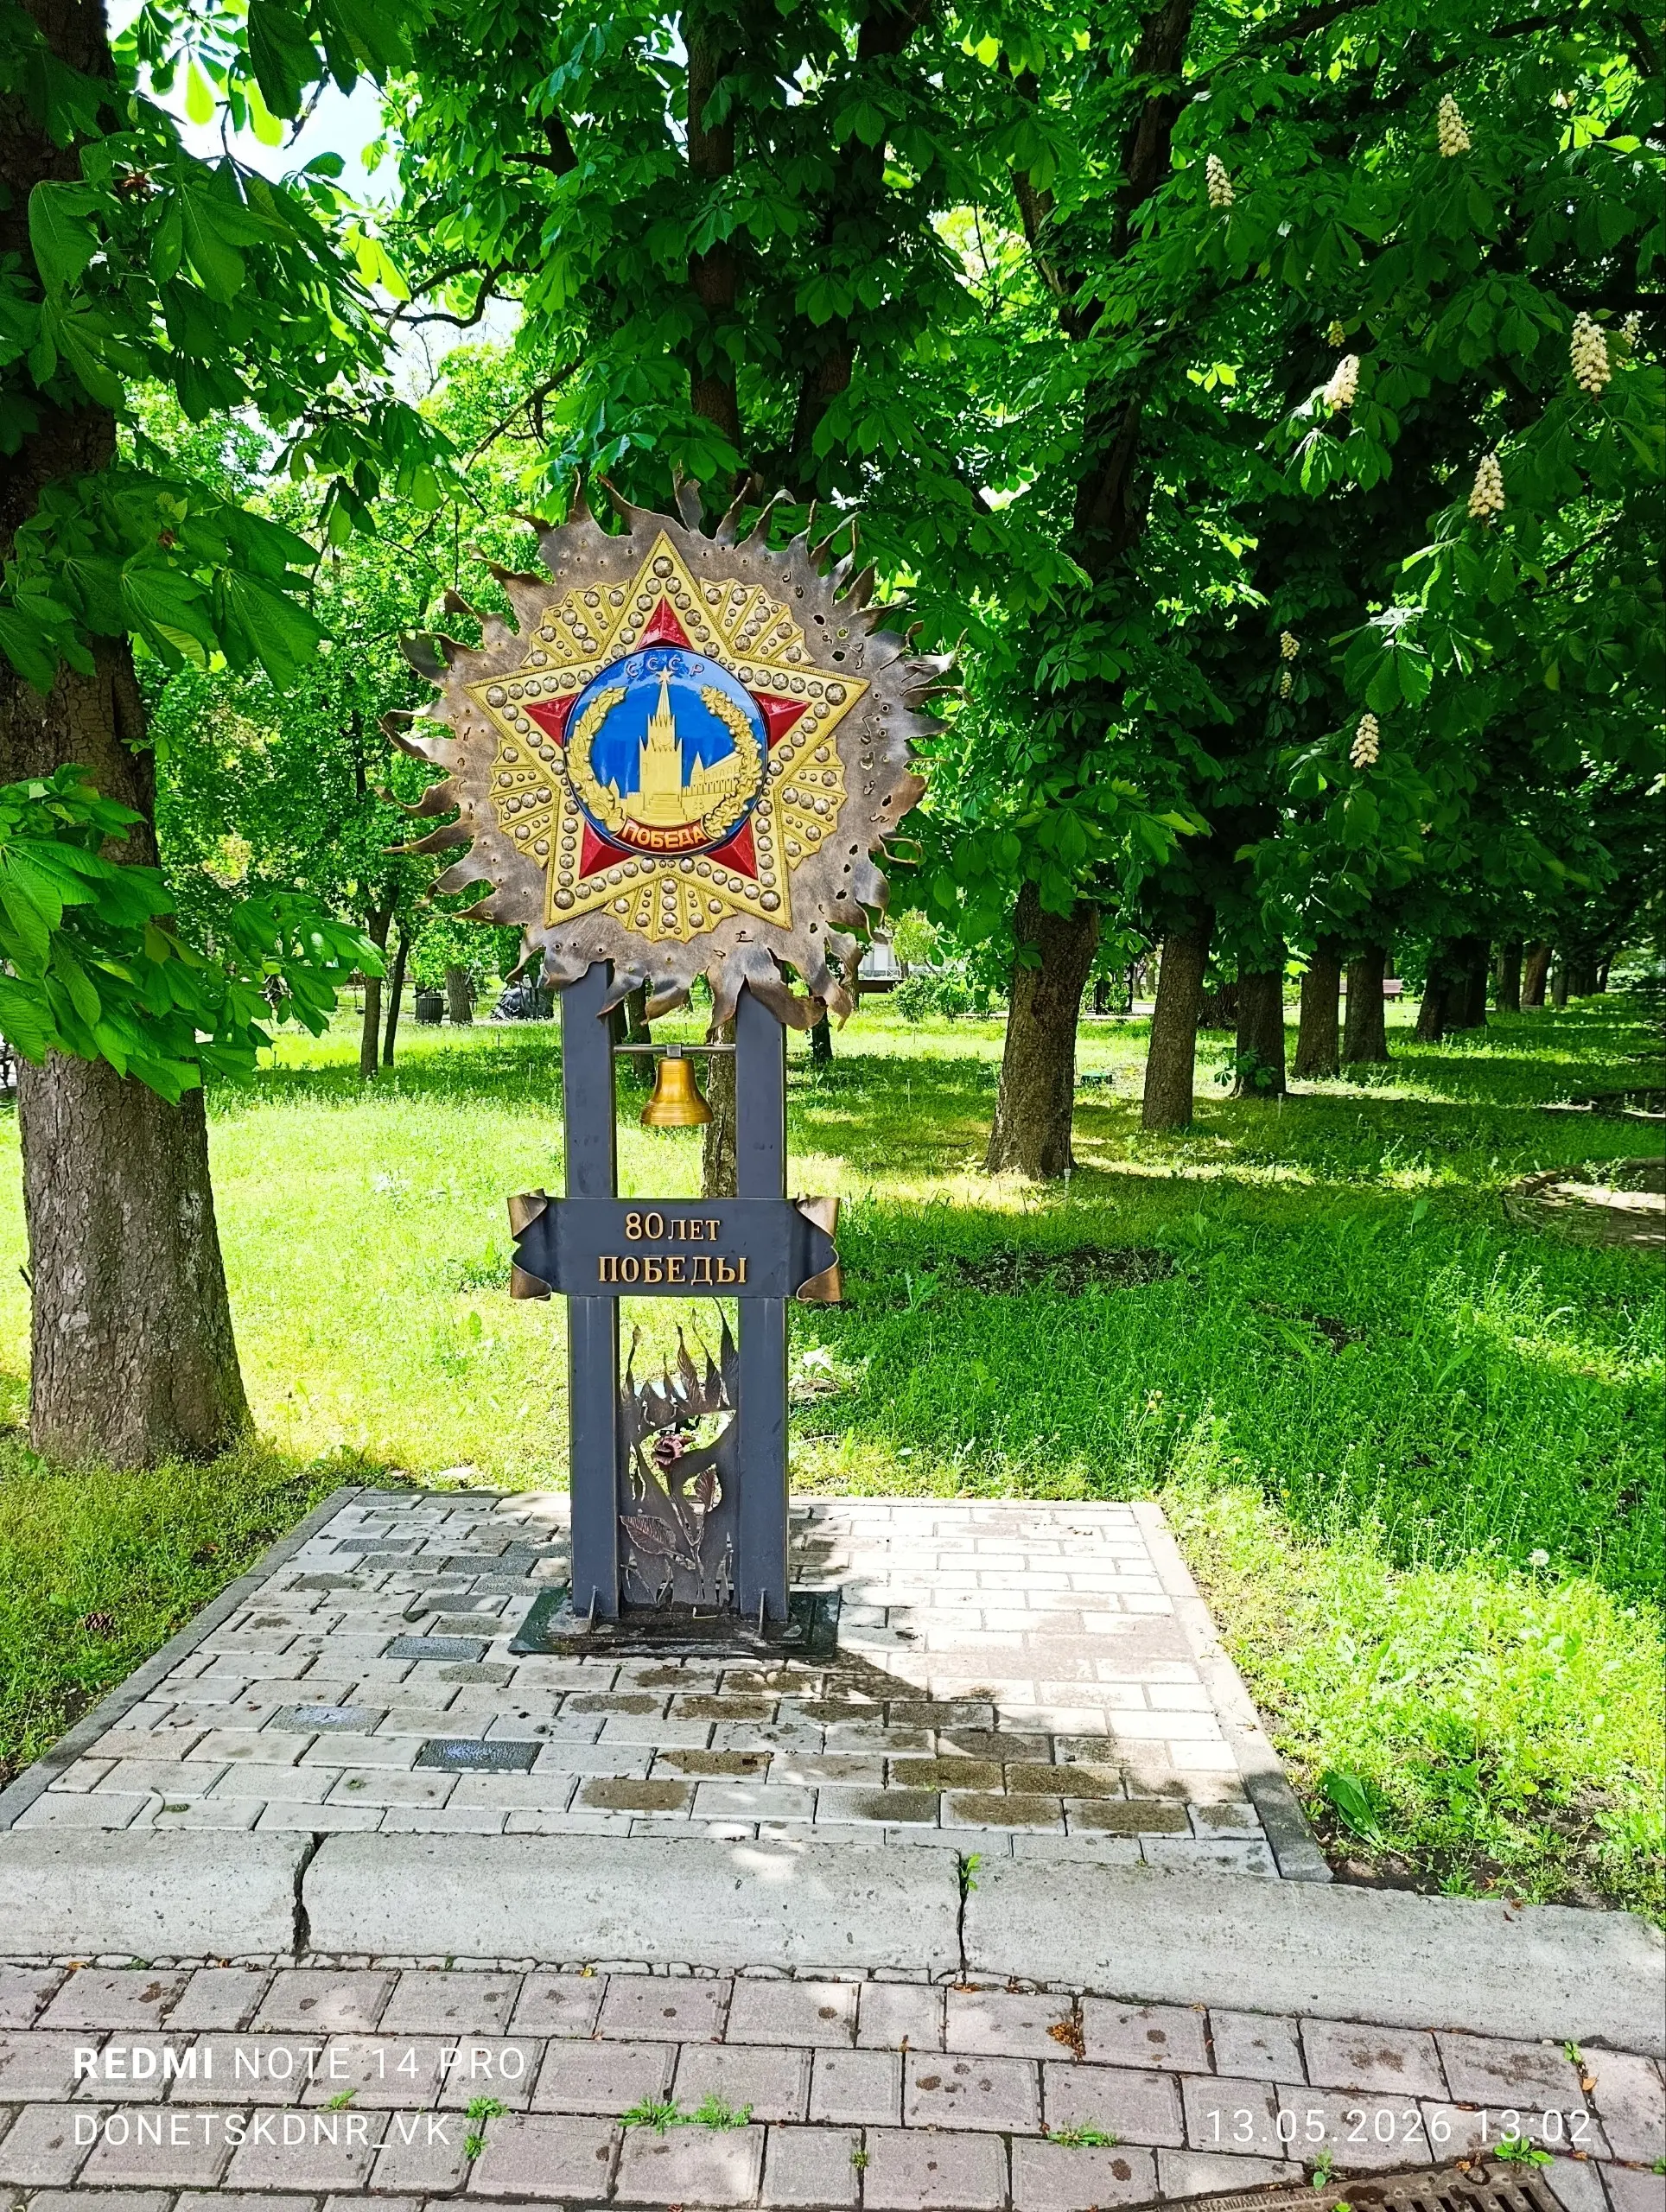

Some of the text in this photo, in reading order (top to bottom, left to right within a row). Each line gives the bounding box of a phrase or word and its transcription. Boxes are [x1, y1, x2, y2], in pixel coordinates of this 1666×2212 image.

[625, 657, 705, 677] СССР
[621, 818, 708, 849] ПОБЕДА
[625, 1211, 722, 1242] 80 ЛЕТ
[597, 1255, 748, 1287] ПОБЕДЫ
